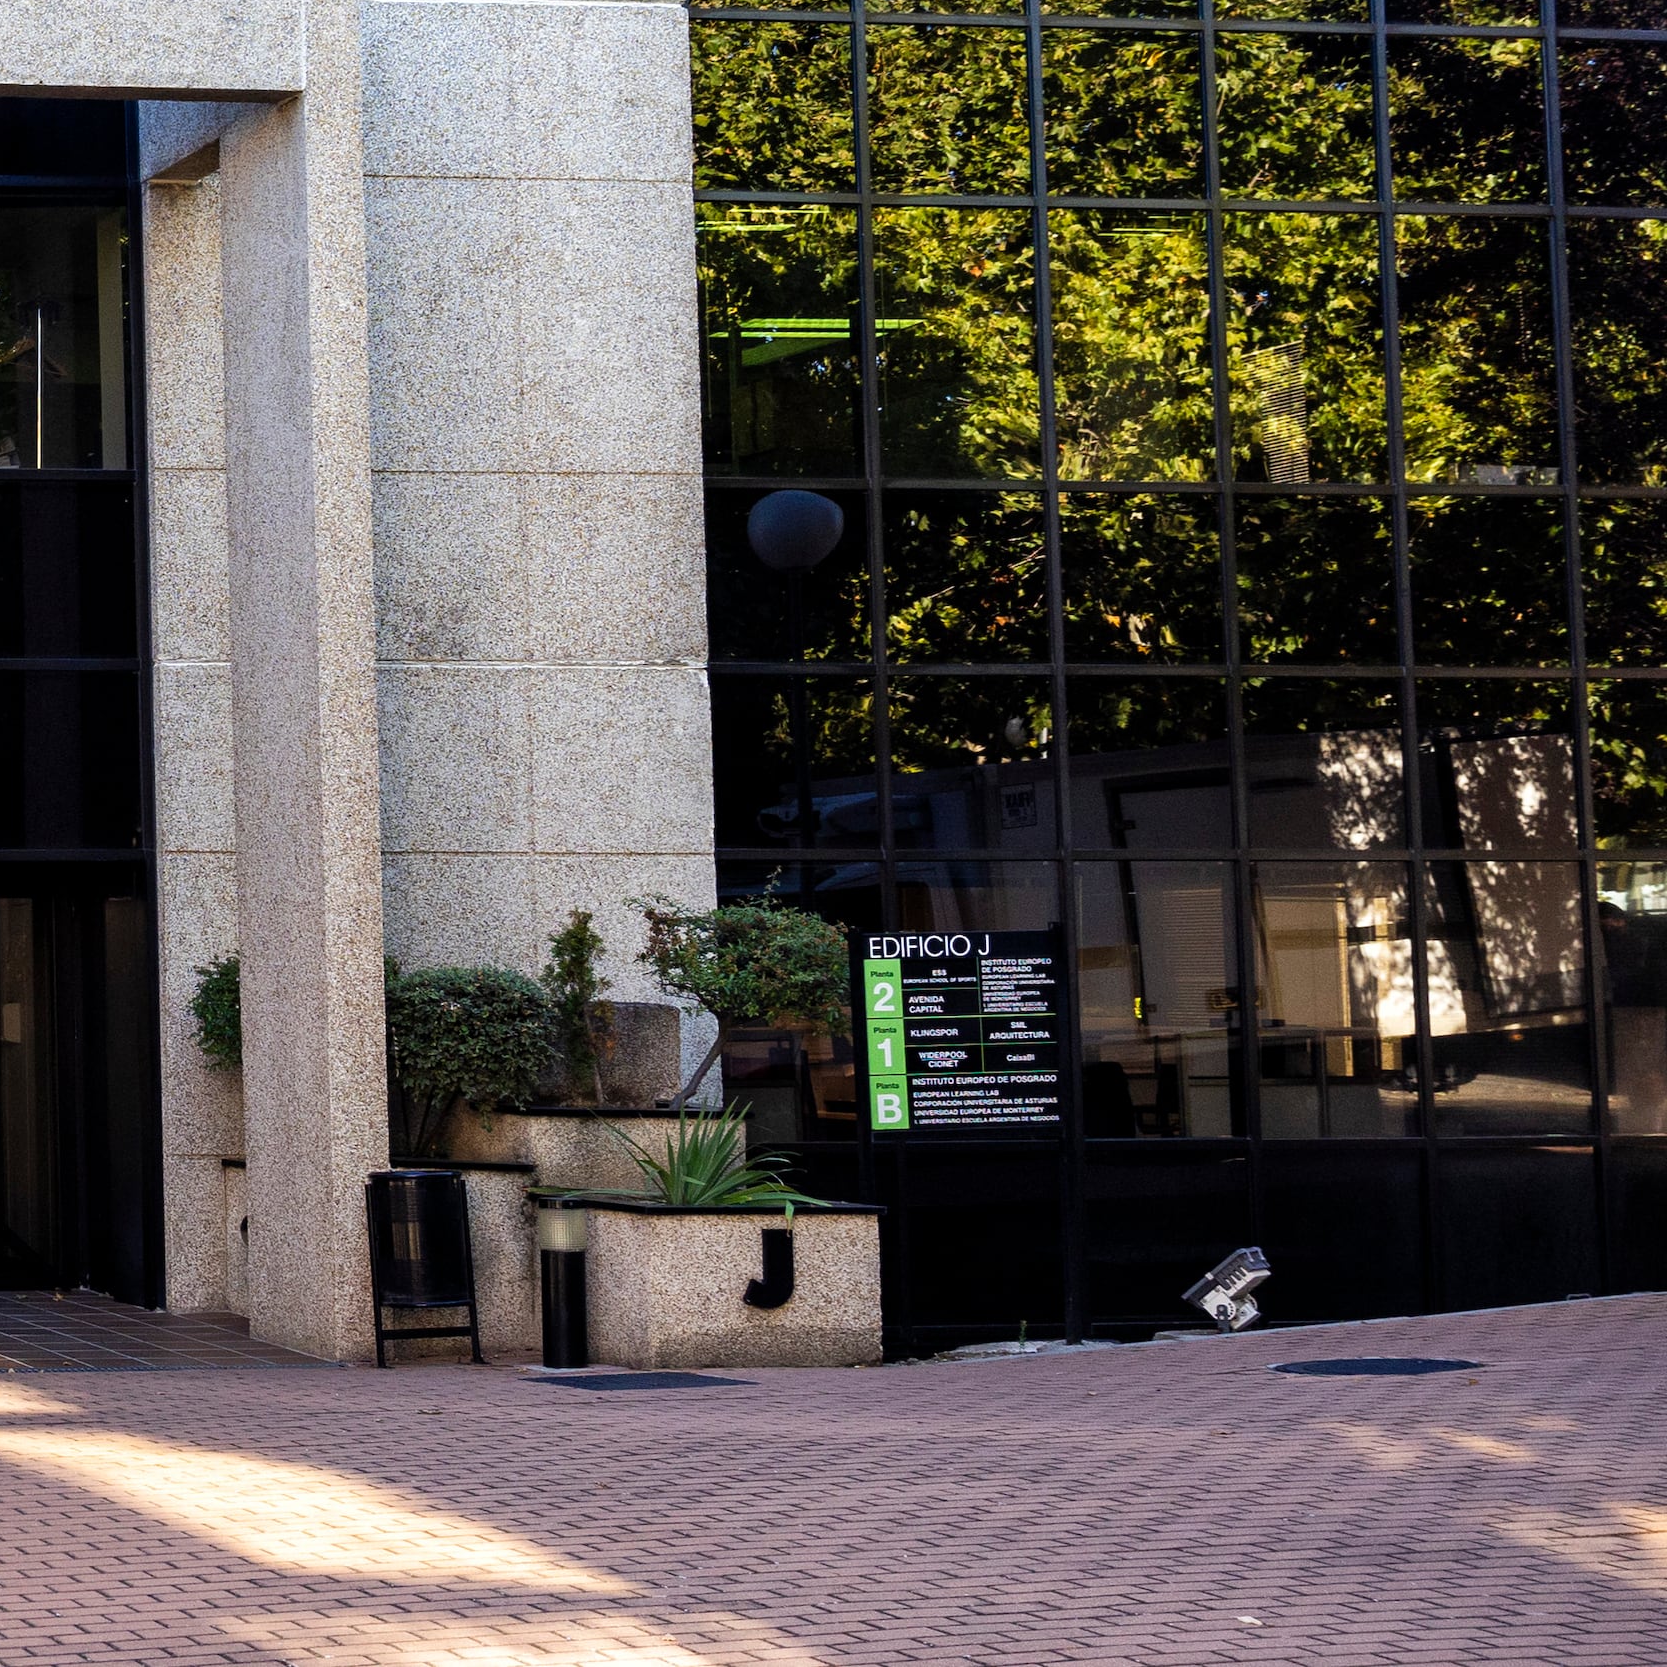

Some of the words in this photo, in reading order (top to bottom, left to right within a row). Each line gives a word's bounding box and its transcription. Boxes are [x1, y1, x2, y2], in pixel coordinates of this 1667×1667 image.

[869, 935, 971, 958] EDIFICIO
[978, 934, 989, 956] J
[873, 982, 895, 1012] 2
[910, 1028, 958, 1037] KLINGSPOR
[989, 1031, 1050, 1040] ARQUITECTURA
[877, 1037, 892, 1067] 1
[928, 1060, 958, 1068] CIONET
[912, 1077, 954, 1085] INSTITUTO
[956, 1076, 996, 1084] EUROPEO
[1010, 1075, 1057, 1083] POSGRADO
[877, 1094, 902, 1123] B
[743, 1229, 794, 1310] J
